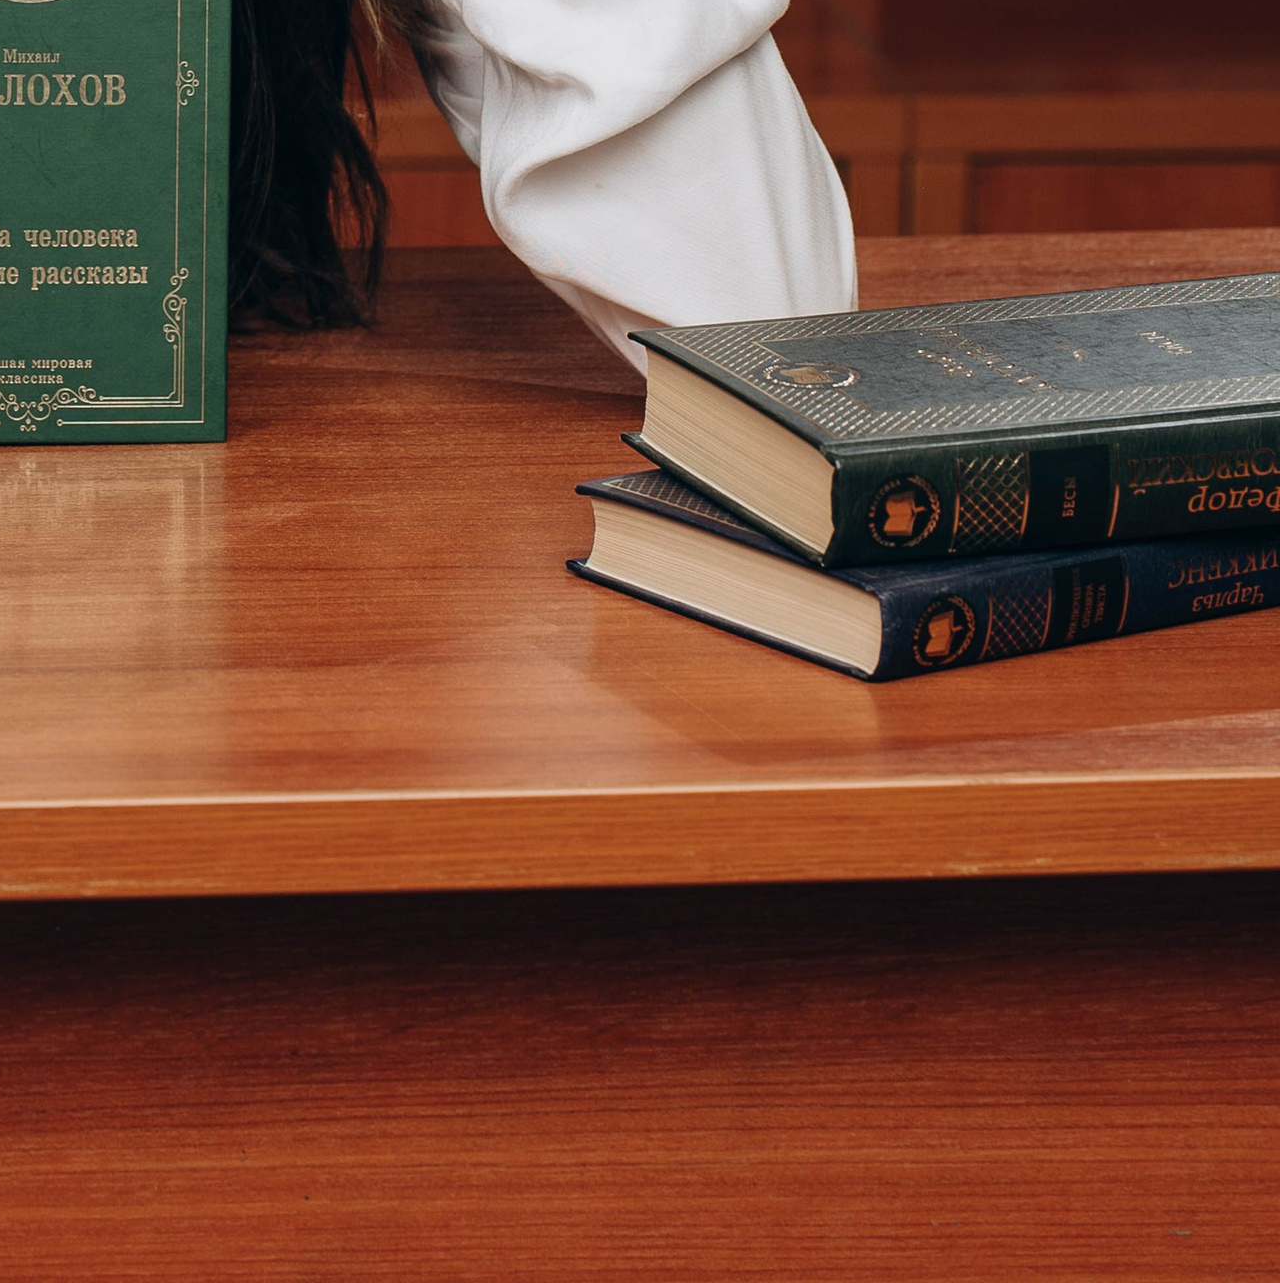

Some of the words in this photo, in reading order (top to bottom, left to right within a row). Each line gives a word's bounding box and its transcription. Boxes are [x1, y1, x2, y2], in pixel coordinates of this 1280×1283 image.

[2, 48, 60, 64] Михаил
[23, 229, 138, 248] человека
[31, 266, 148, 291] рассказы
[31, 358, 93, 370] мировая
[1127, 447, 1280, 495] ОЕВСКИЙ
[1062, 476, 1077, 517] БЕСЫ
[1192, 581, 1265, 613] Чарльз
